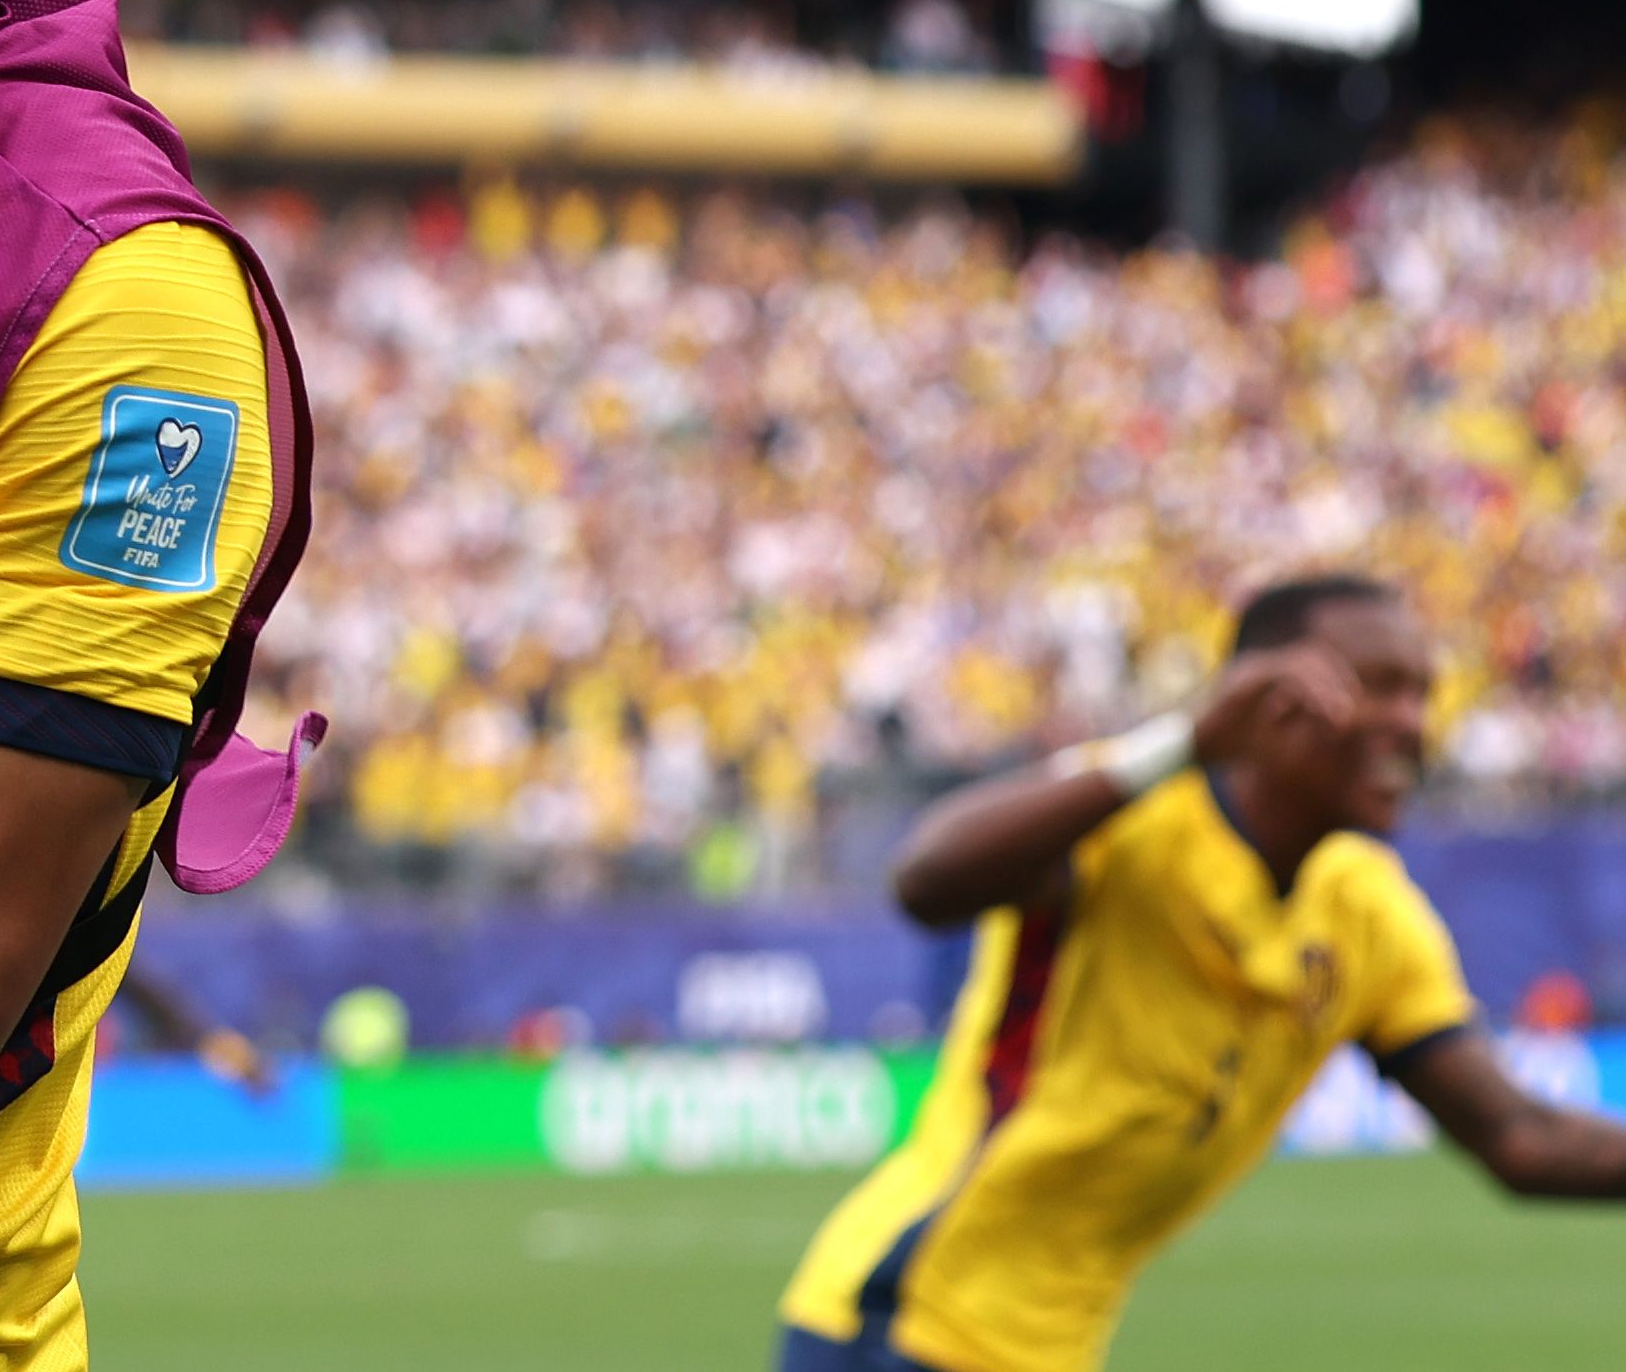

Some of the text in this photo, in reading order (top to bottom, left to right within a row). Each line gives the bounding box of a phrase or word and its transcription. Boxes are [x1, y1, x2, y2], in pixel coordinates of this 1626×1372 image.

[125, 474, 198, 515] Unite For
[117, 508, 186, 549] PEACE
[123, 547, 160, 568] FIFA
